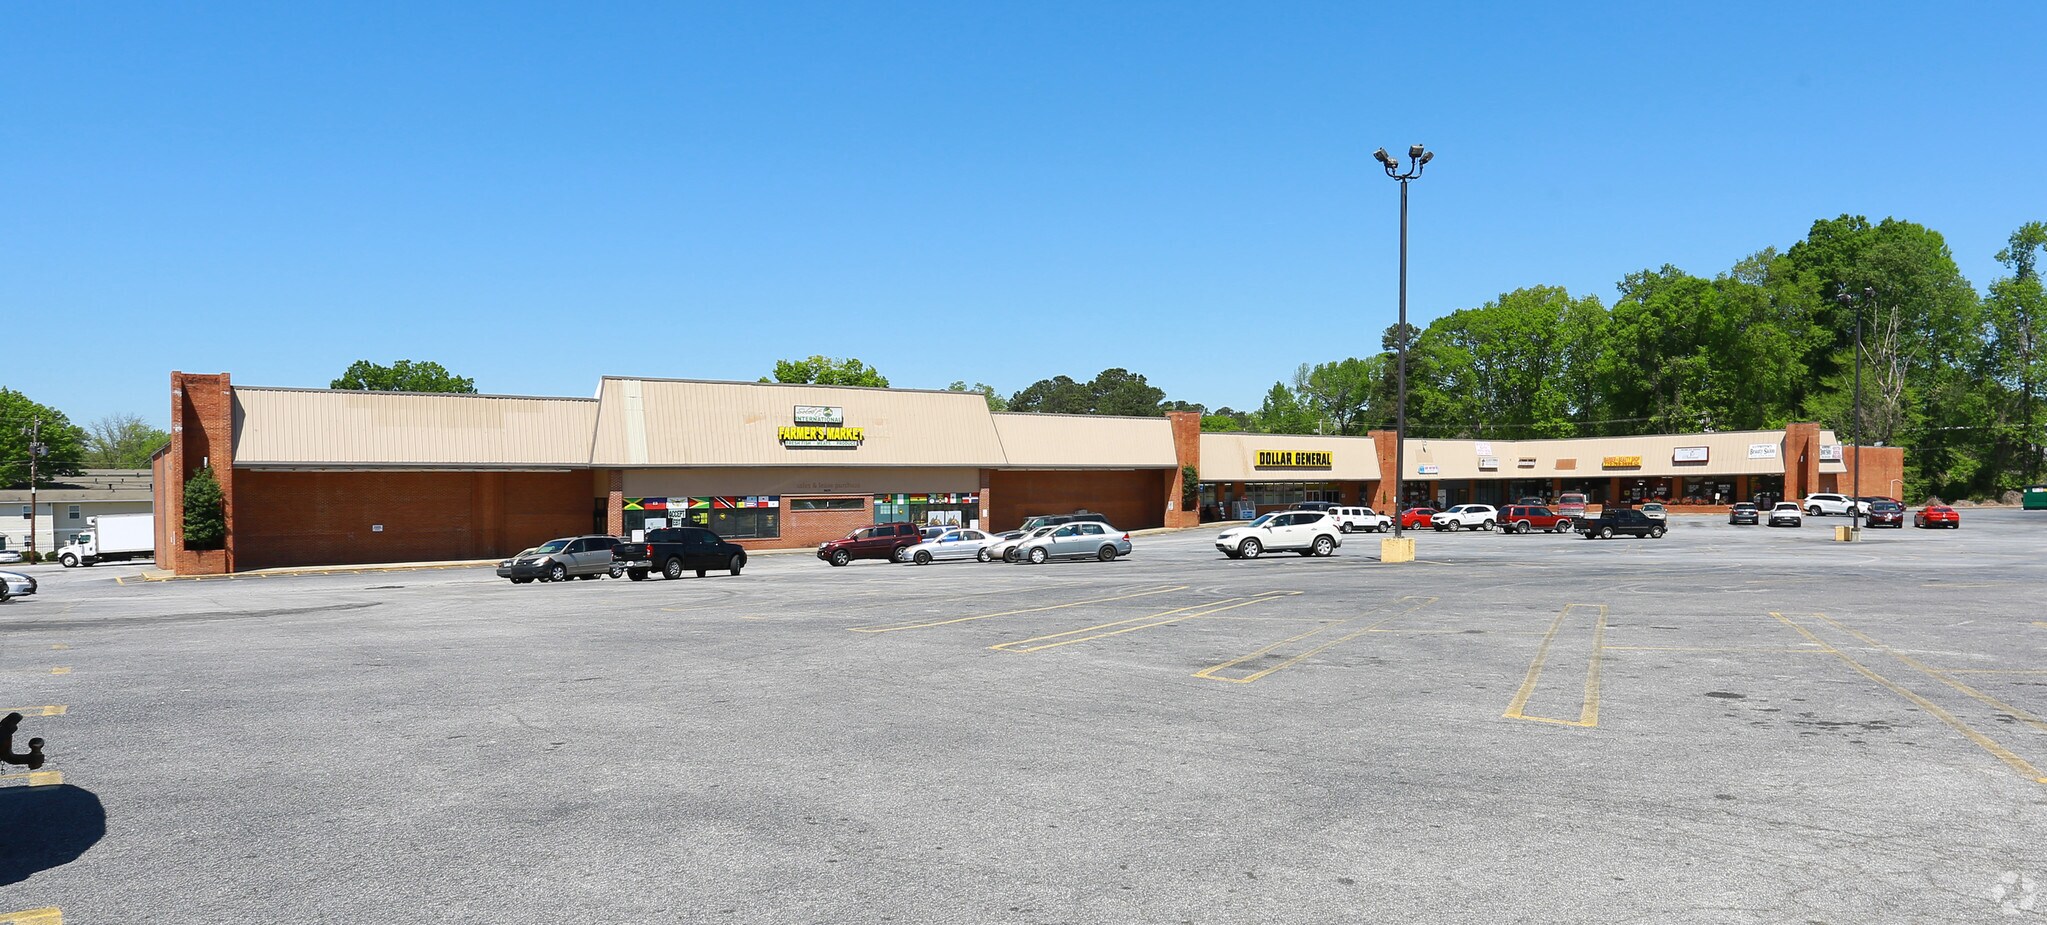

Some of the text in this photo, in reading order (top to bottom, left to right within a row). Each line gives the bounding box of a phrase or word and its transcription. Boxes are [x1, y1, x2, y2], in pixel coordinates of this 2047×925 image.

[778, 426, 864, 440] FARMER'S MARKET
[1259, 452, 1331, 465] DOLLAR GENERAL
